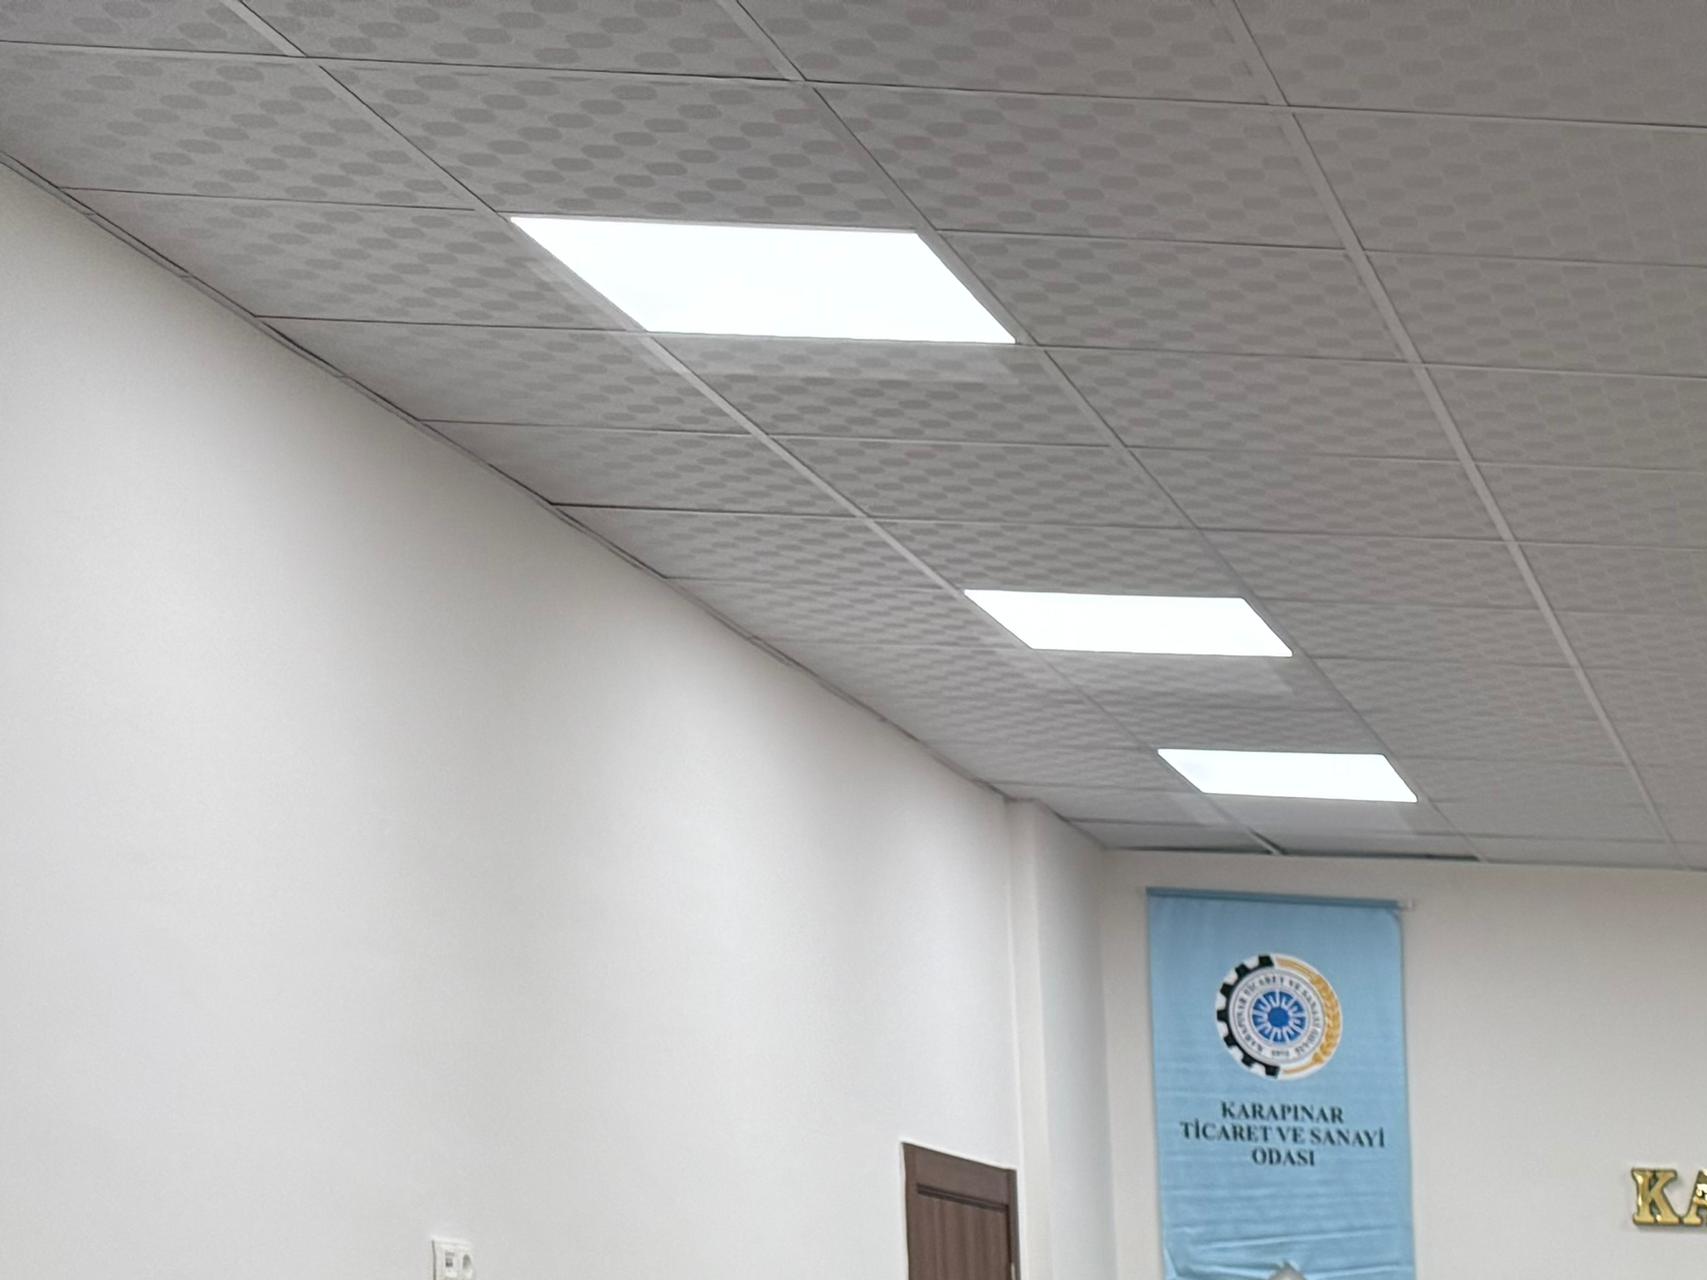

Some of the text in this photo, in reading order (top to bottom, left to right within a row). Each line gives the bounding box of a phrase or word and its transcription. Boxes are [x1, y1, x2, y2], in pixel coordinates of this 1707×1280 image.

[1220, 1100, 1345, 1124] KARAPINAR
[1179, 1118, 1386, 1149] TİCARET VE SANAYİ
[1251, 1148, 1316, 1167] ODASI
